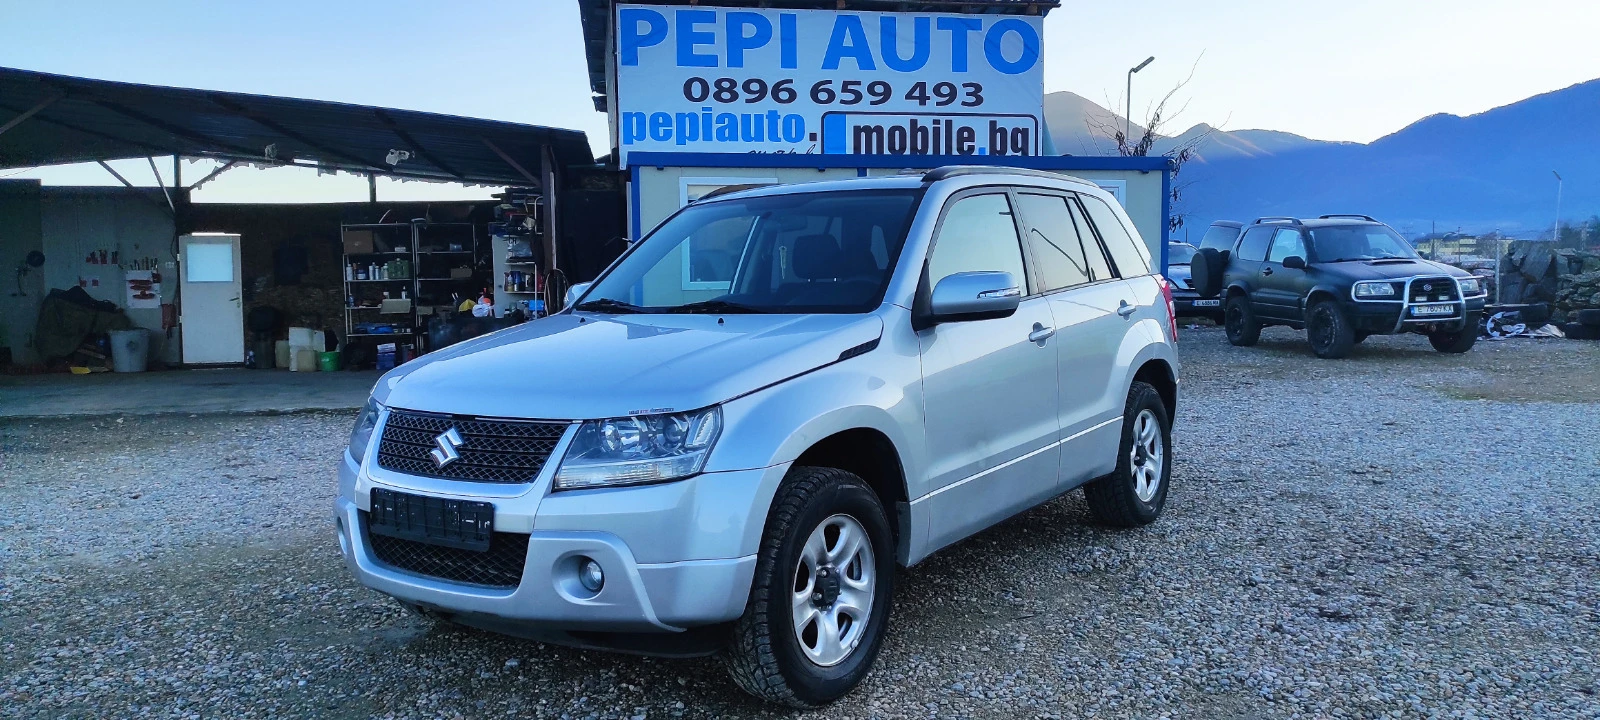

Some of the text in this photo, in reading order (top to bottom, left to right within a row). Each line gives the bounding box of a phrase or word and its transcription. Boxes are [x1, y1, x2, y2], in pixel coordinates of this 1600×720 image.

[620, 8, 1040, 75] PEPI AUTO
[683, 77, 984, 107] 0896 659 493
[852, 118, 1030, 156] mobile.bg
